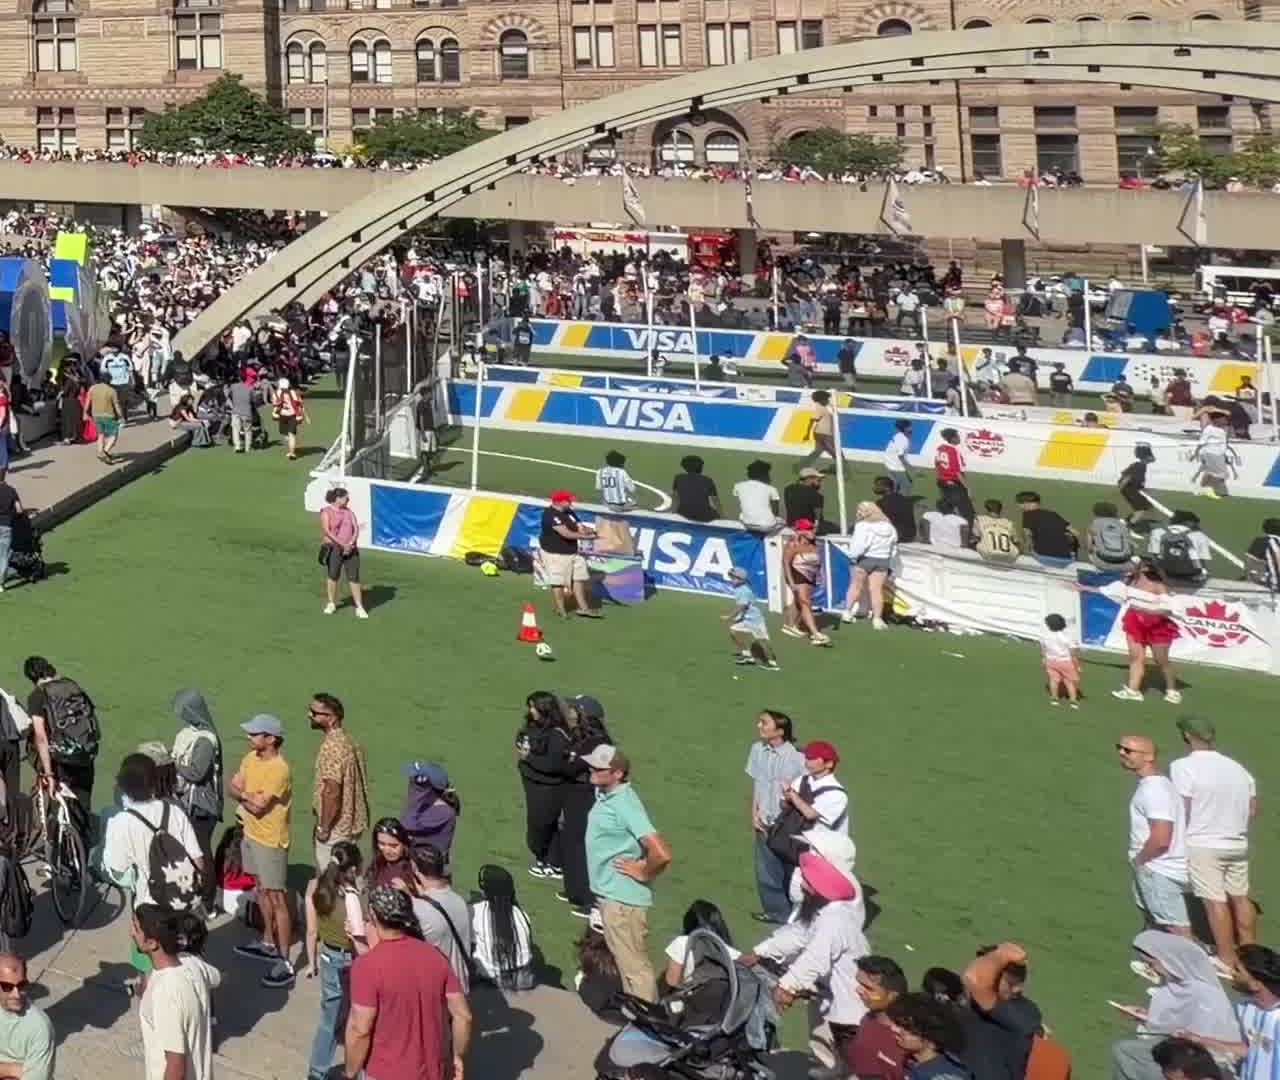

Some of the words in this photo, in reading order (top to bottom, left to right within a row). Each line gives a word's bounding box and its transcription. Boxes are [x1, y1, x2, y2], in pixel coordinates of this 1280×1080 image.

[623, 328, 696, 351] VISA
[590, 395, 695, 432] VISA
[628, 526, 737, 581] ISA
[988, 530, 1011, 553] 10
